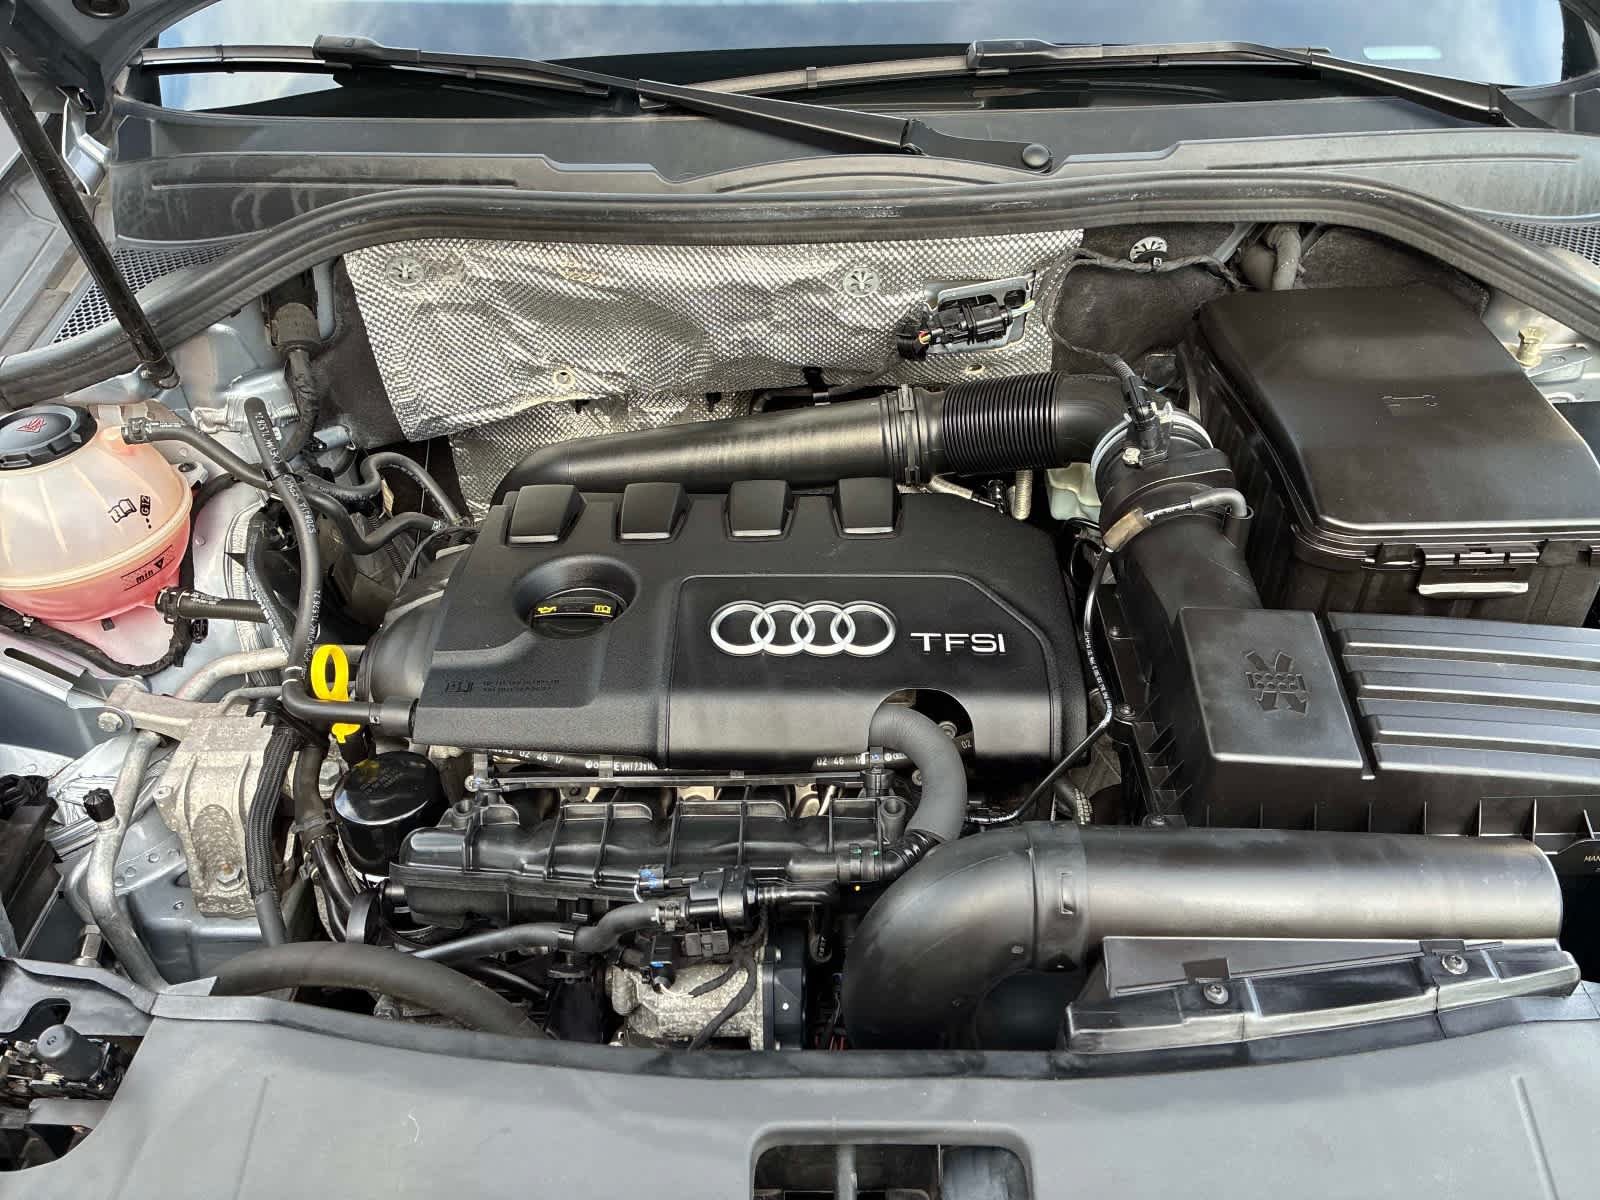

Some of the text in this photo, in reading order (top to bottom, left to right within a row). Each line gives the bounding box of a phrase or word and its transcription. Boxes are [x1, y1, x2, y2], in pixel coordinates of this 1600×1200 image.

[136, 569, 154, 584] min
[911, 632, 1006, 655] TFSI
[816, 756, 828, 766] 02
[833, 756, 845, 766] 46
